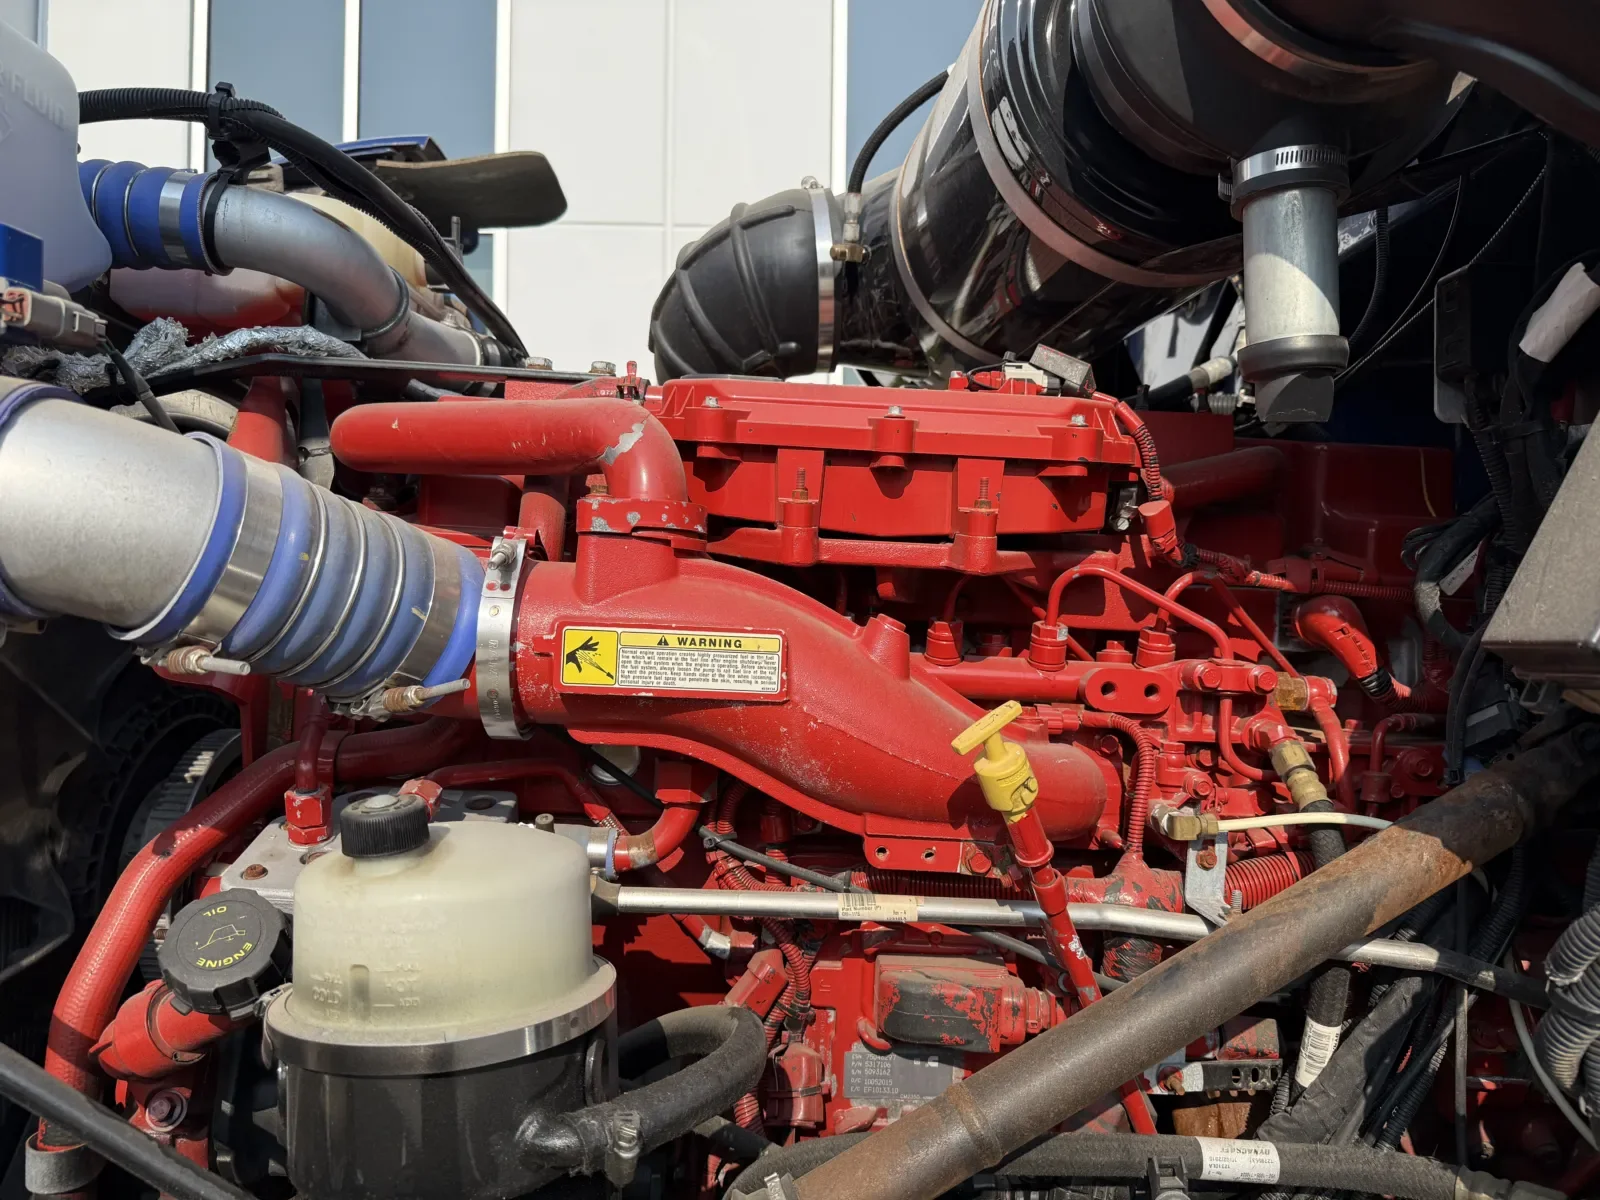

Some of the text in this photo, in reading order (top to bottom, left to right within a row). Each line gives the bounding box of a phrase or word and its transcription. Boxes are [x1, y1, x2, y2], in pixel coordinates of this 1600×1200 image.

[11, 71, 66, 128] FLUID
[677, 637, 742, 648] WARNING
[203, 906, 227, 916] OIL
[196, 942, 252, 968] ENGINE
[312, 985, 342, 1004] COLD
